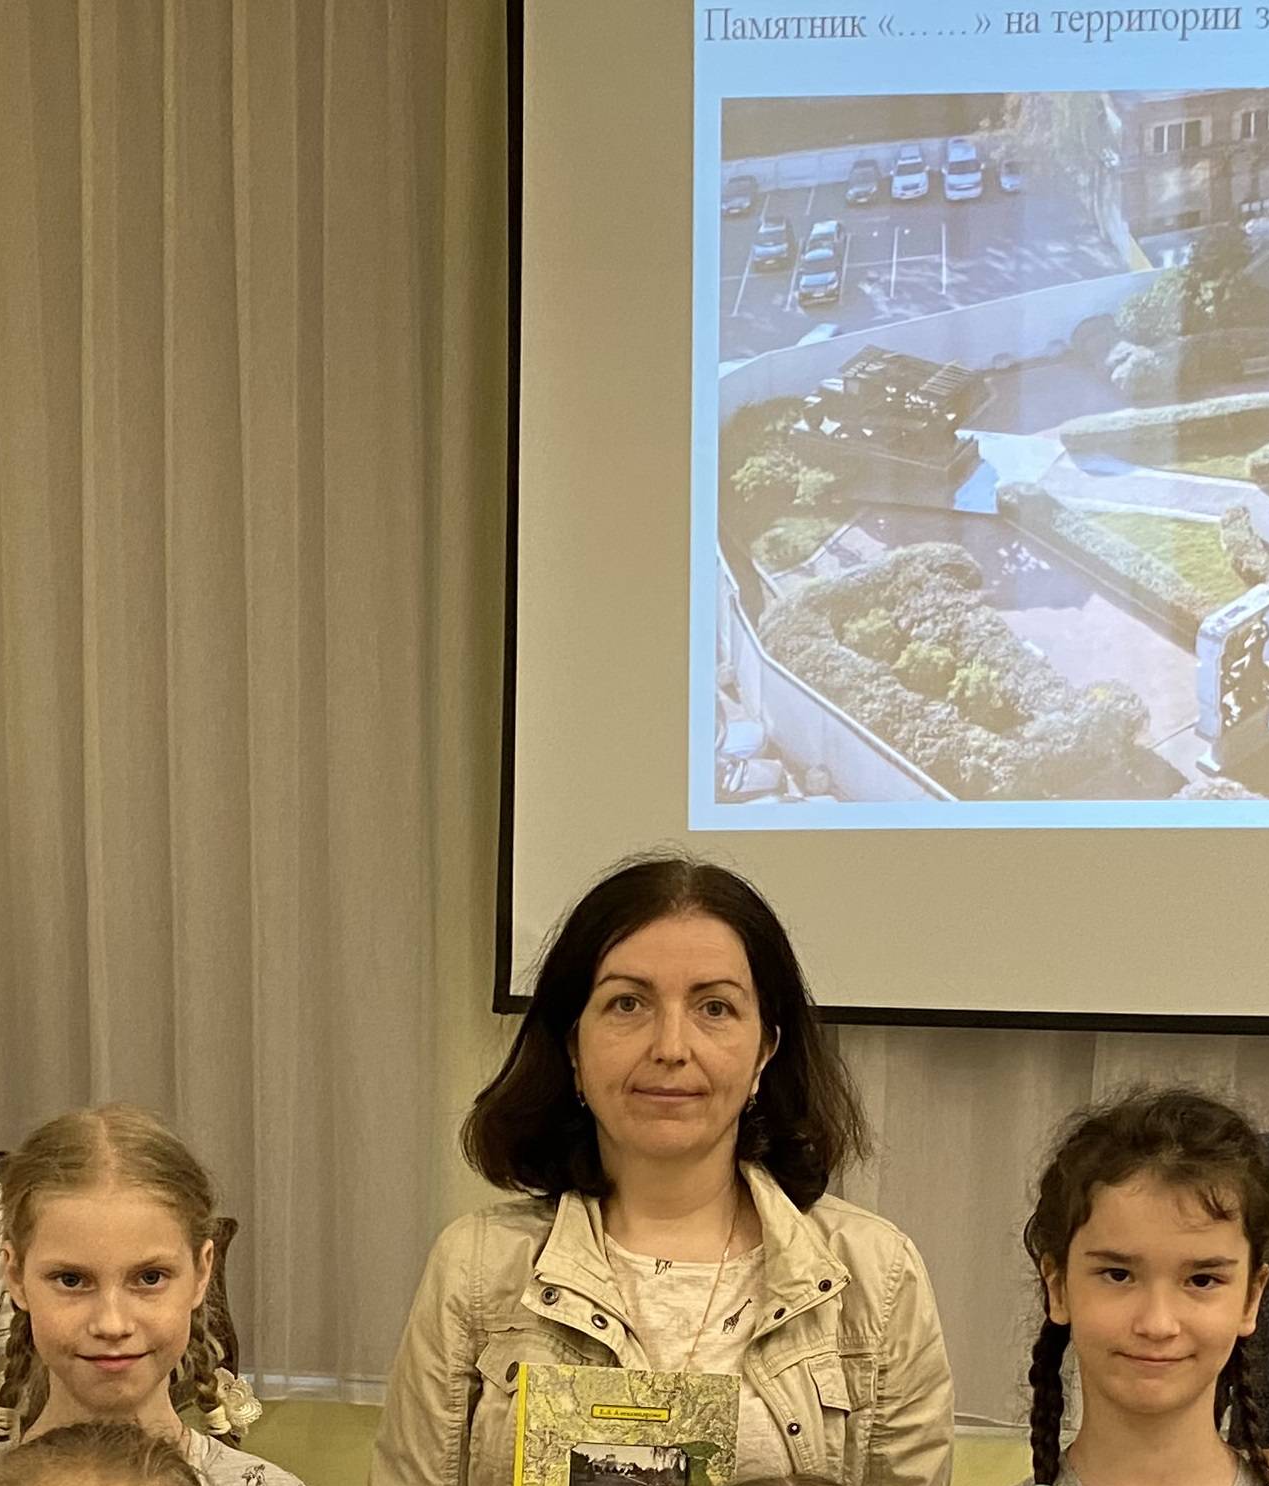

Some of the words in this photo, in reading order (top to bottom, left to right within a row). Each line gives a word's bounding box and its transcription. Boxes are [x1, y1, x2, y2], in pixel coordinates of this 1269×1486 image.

[704, 7, 867, 42] Памятник
[1004, 11, 1041, 35] на
[1051, 6, 1242, 43] территории
